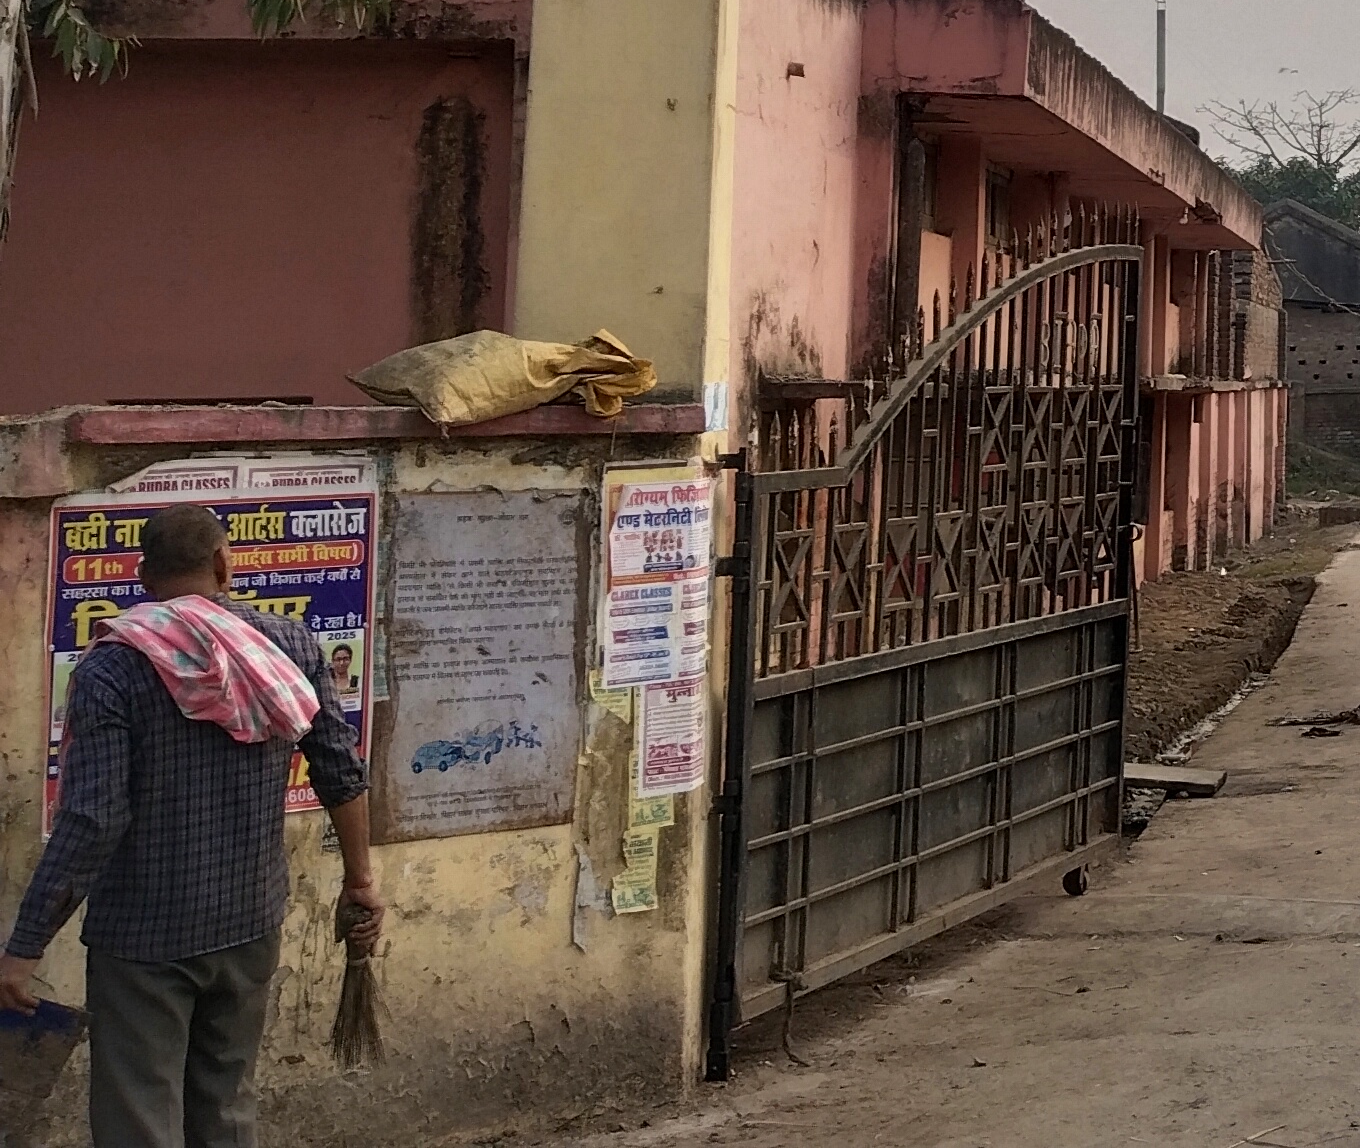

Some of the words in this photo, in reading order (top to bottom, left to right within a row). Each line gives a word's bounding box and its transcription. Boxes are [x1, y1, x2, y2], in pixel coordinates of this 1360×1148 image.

[63, 512, 111, 551] बद्री
[72, 557, 123, 581] 11th
[327, 632, 357, 641] 2025
